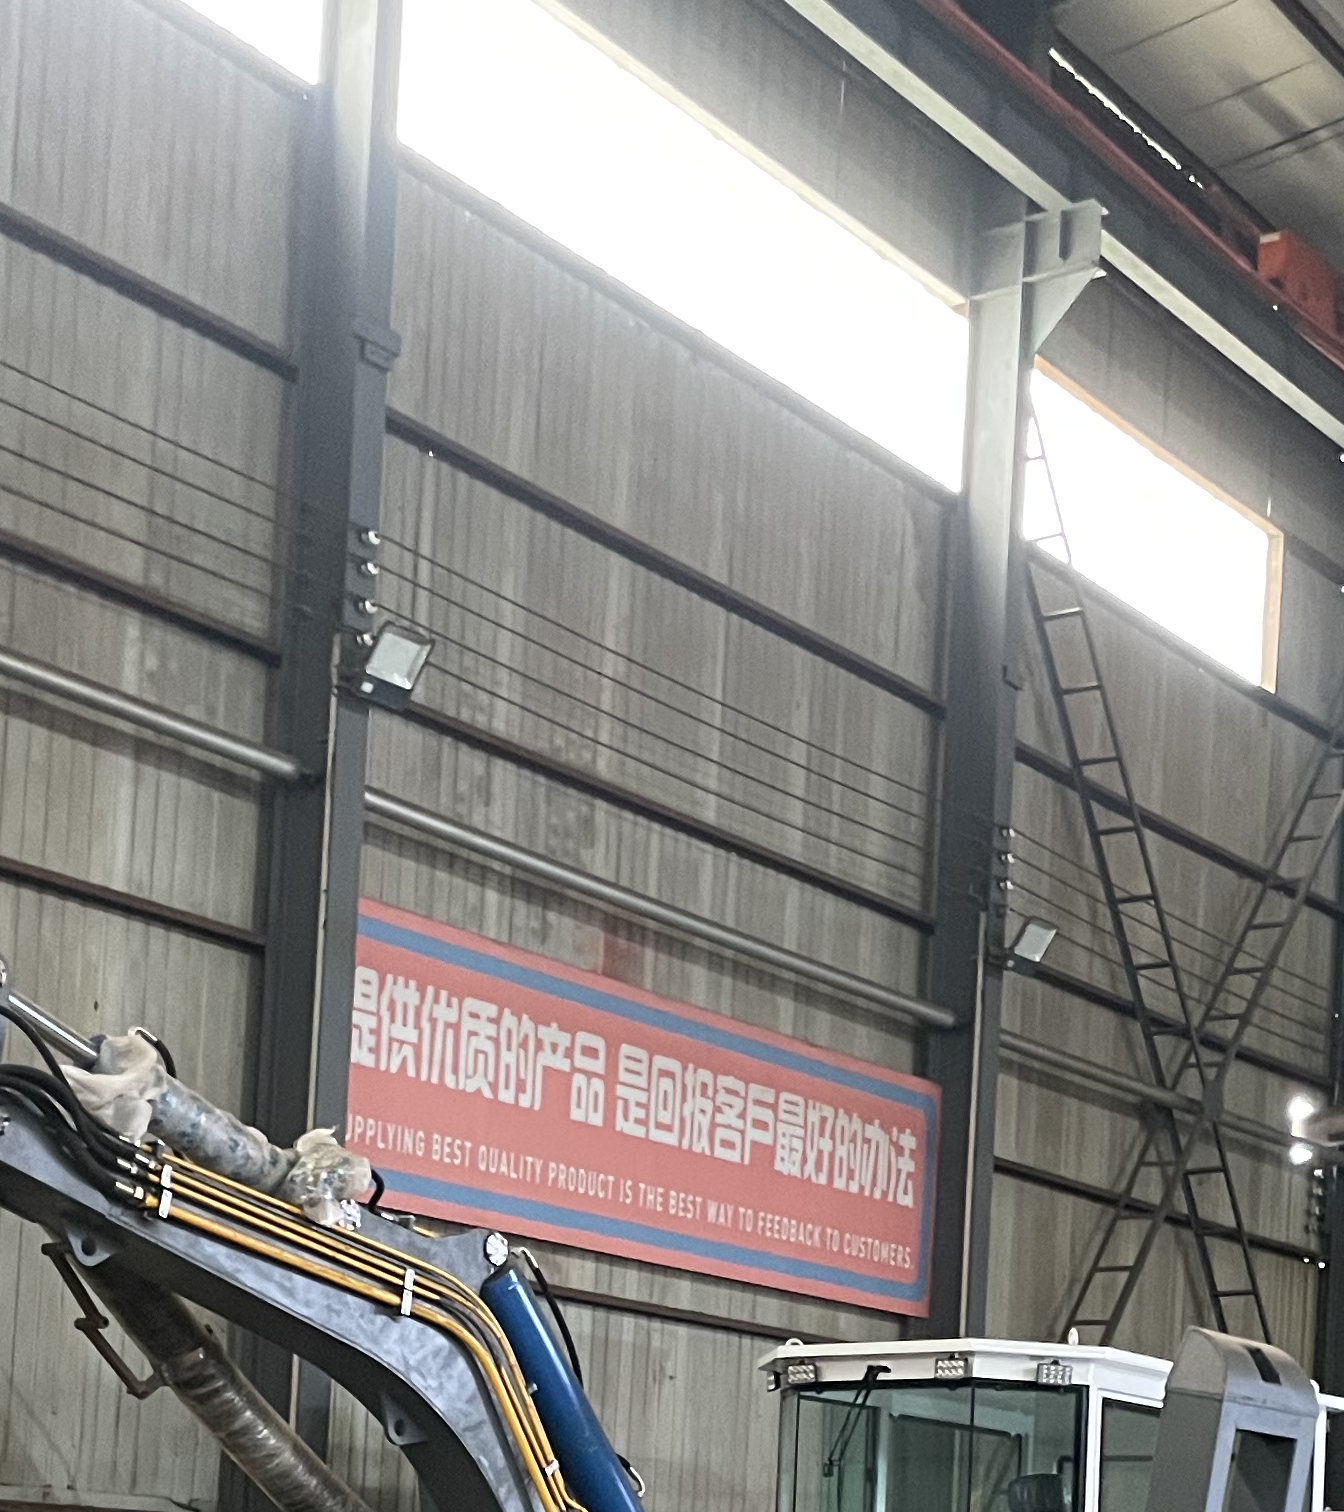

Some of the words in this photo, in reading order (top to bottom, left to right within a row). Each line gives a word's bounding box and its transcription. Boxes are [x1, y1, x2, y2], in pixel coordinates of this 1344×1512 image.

[432, 1133, 472, 1167] BEST
[478, 1145, 543, 1180] QUALITY
[548, 1161, 614, 1200] PRODUCT
[619, 1178, 632, 1205] IS
[638, 1183, 665, 1212] THE
[669, 1190, 702, 1220] BEST
[707, 1200, 735, 1228] WAY
[738, 1207, 753, 1232] TO
[757, 1212, 821, 1248] FEEDBACK
[826, 1228, 840, 1253] TO
[615, 1043, 916, 1208] 是回报客户最好的办法
